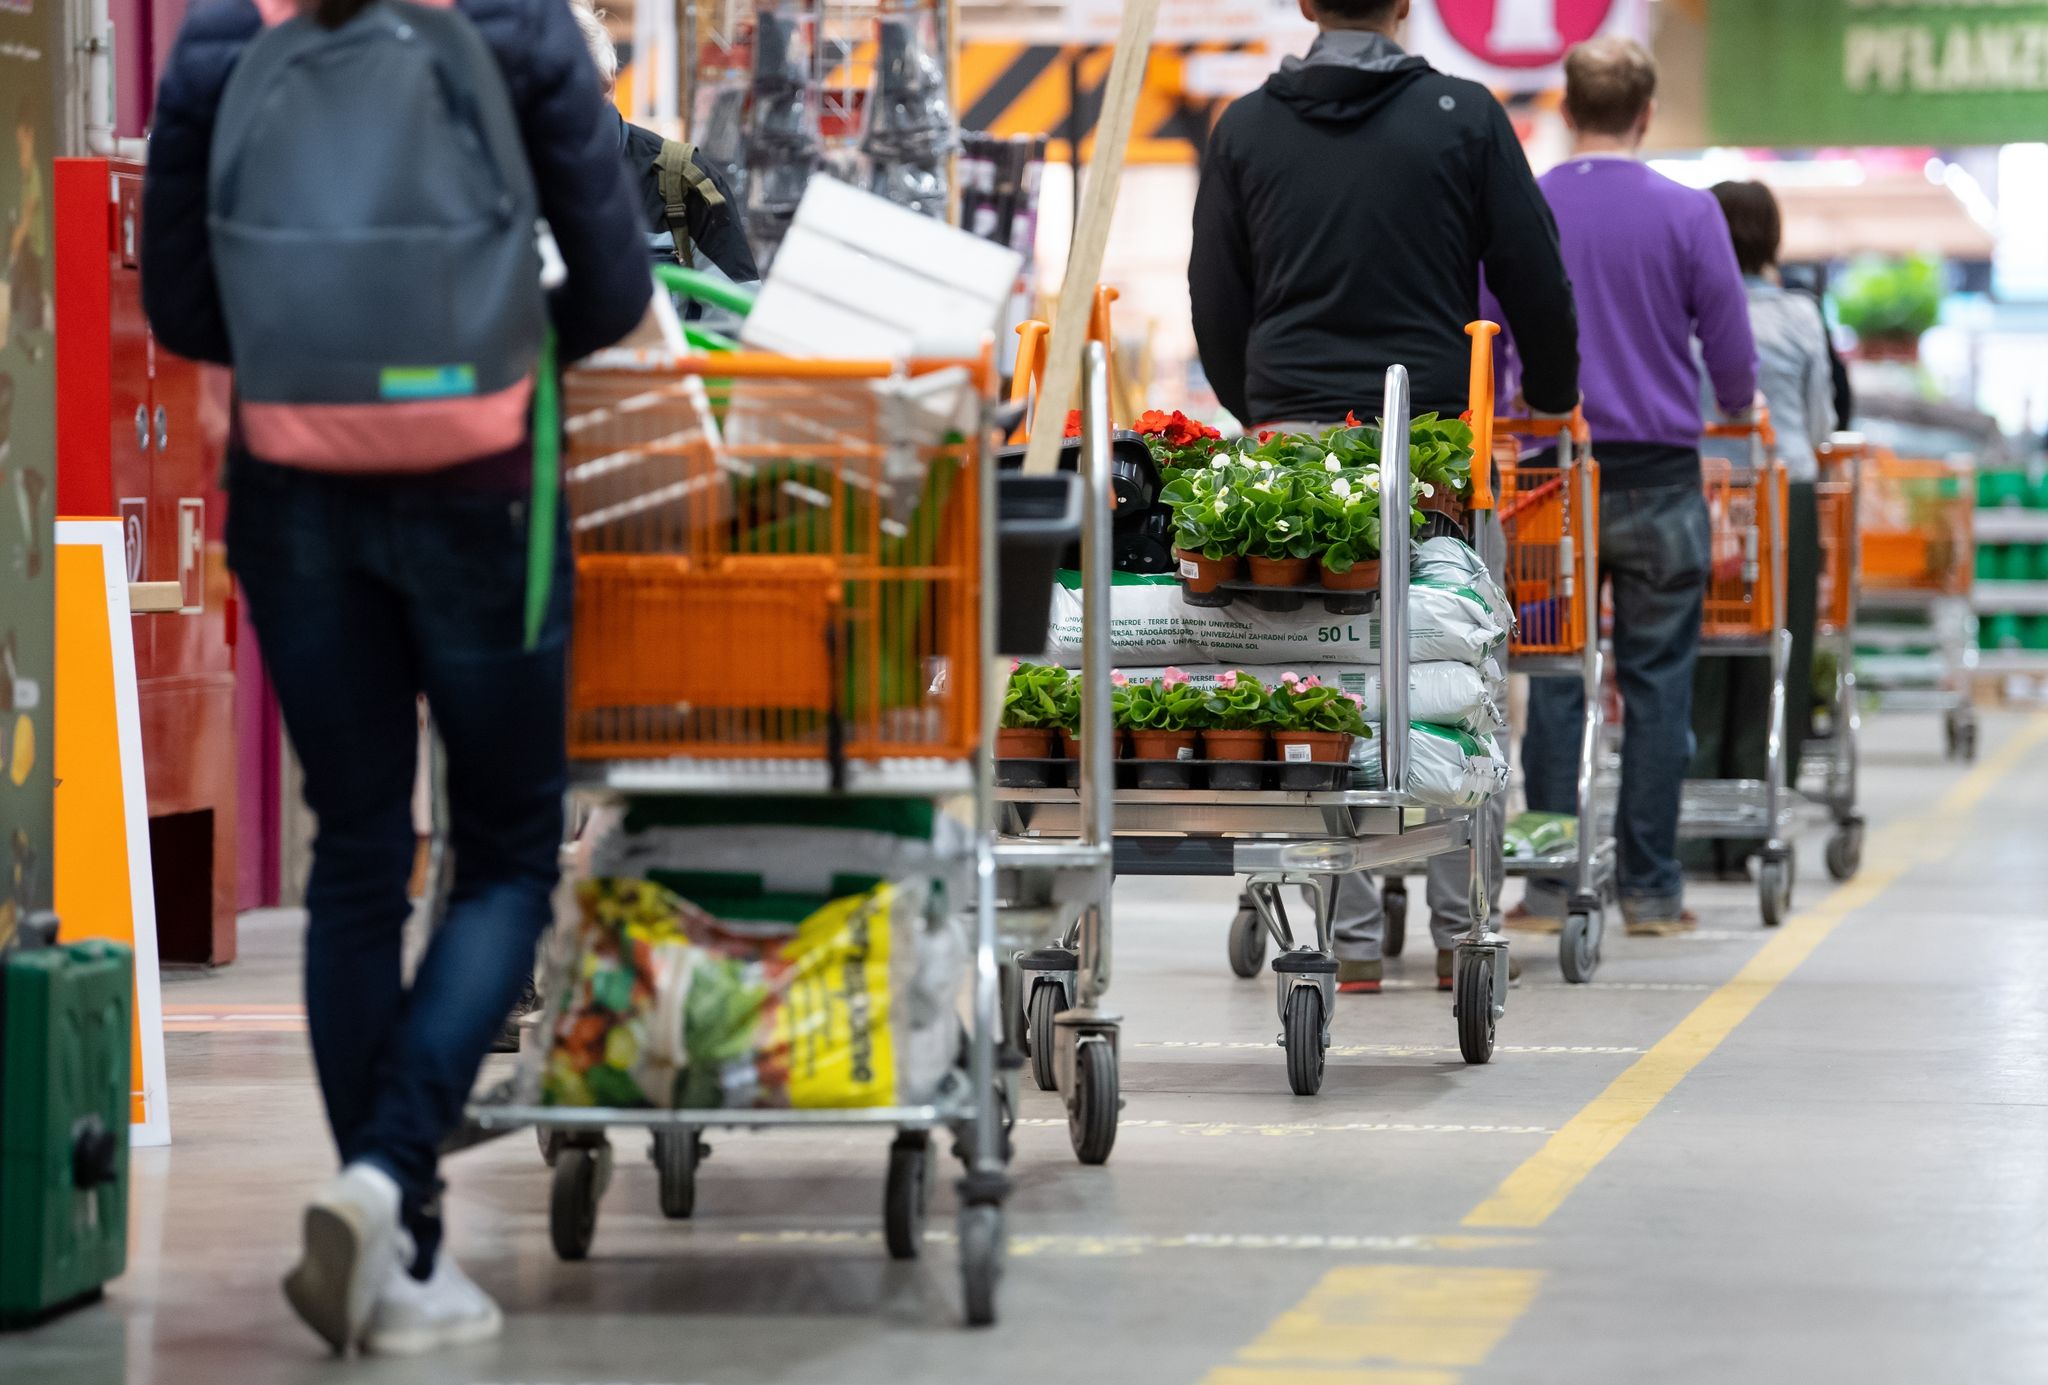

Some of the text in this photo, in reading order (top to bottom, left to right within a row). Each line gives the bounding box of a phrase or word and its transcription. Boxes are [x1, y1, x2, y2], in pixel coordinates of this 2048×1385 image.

[1181, 619, 1207, 627] JARDIN
[1208, 621, 1253, 630] UNIVERSELLE
[1318, 625, 1360, 642] 50 L
[1210, 641, 1244, 649] GRADINA
